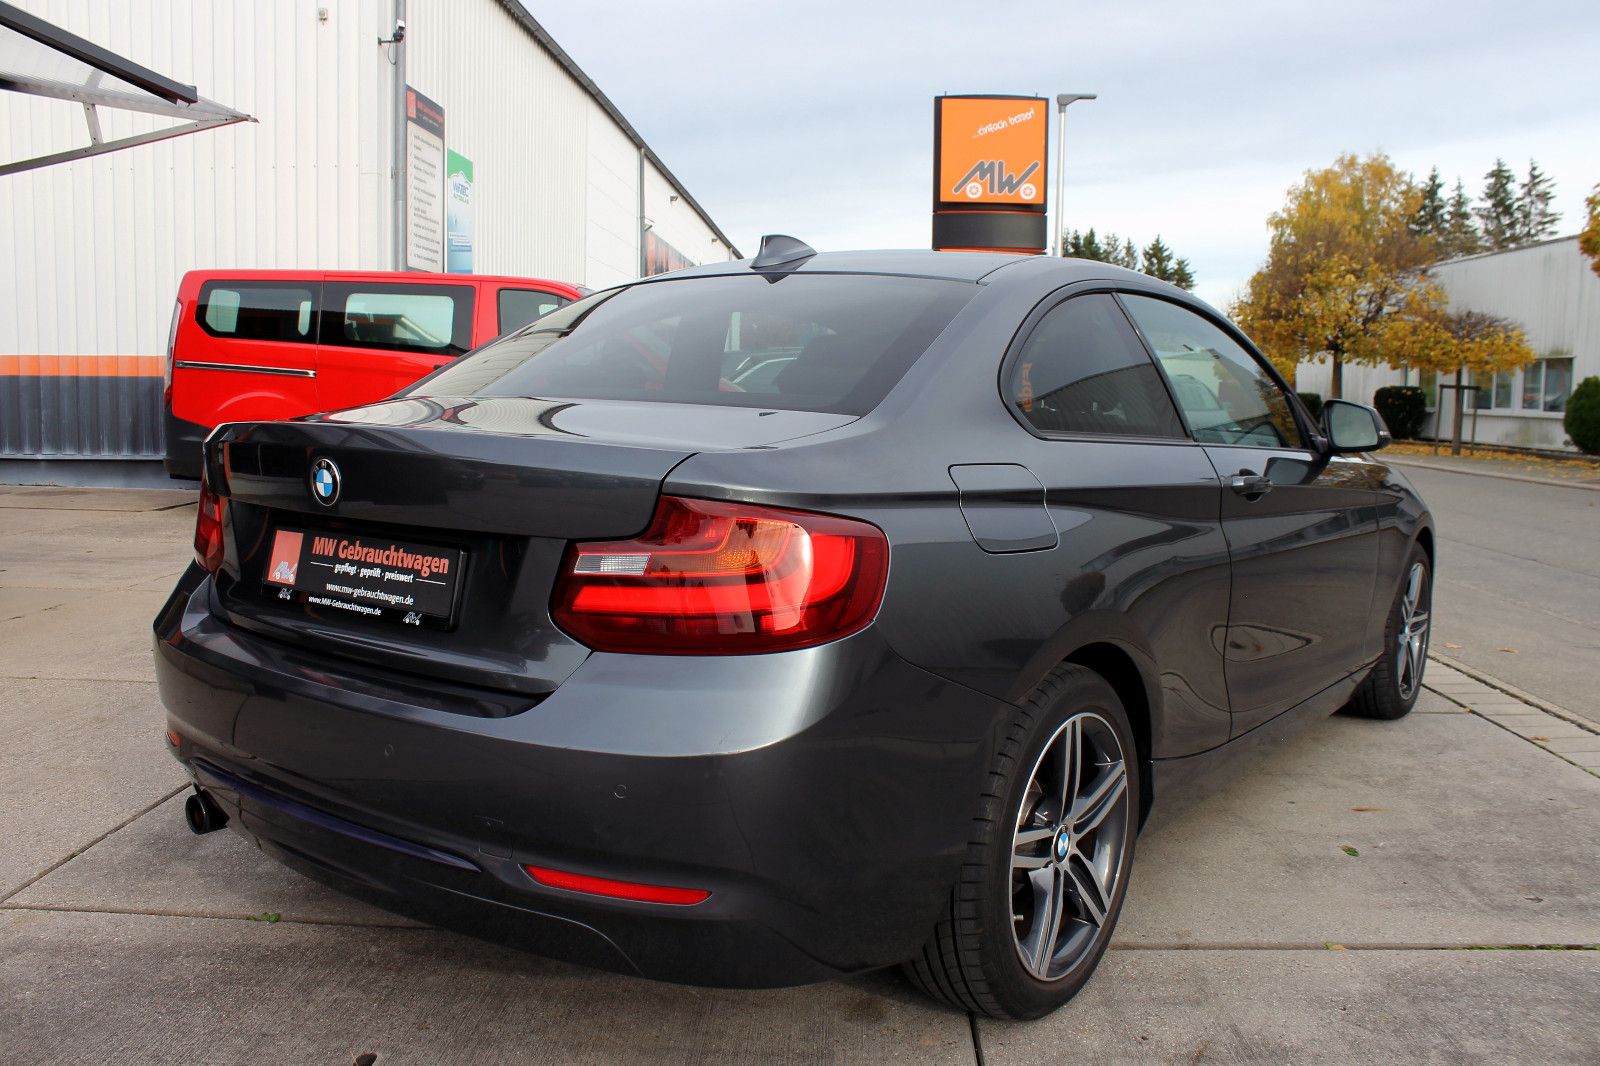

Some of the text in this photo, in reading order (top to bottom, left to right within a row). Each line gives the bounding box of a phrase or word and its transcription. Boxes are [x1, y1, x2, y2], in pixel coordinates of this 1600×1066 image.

[953, 160, 1040, 195] MW
[312, 536, 449, 577] MW Gebrauchtwagen
[334, 563, 414, 583] gepflegt geprüft preiswert
[308, 596, 382, 616] www.MW-Gebrauchtwagen.de
[326, 583, 414, 606] www.mw-gebrauchtwagen.de
